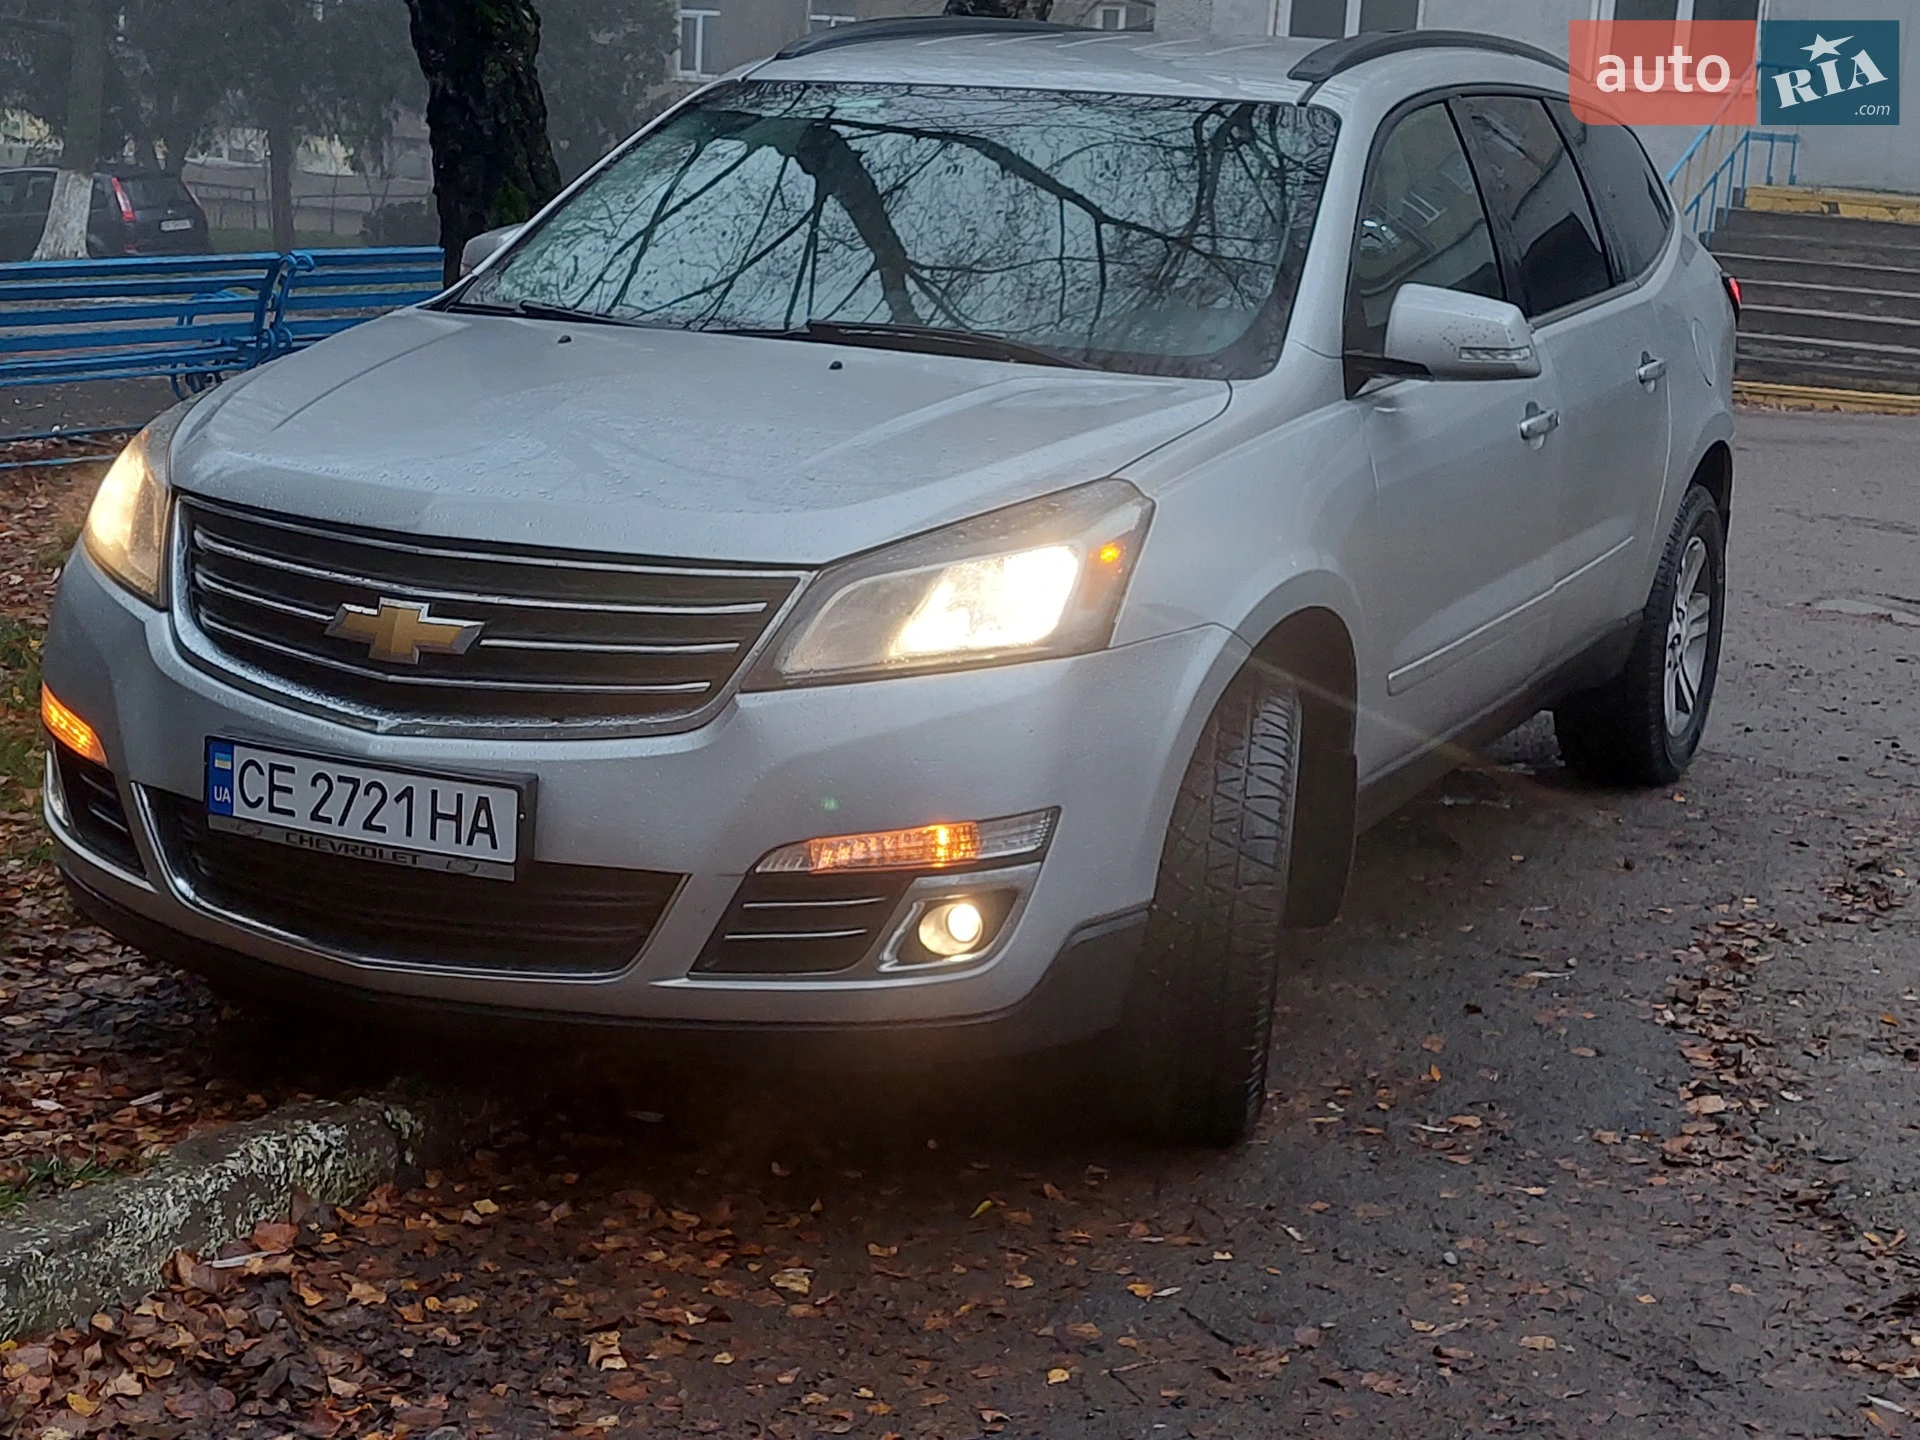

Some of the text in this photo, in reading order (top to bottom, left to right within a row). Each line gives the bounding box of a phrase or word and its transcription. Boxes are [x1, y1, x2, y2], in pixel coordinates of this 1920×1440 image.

[213, 785, 231, 804] UA
[238, 758, 499, 850] CE 2721 HA
[285, 831, 421, 866] CHEVROLET
